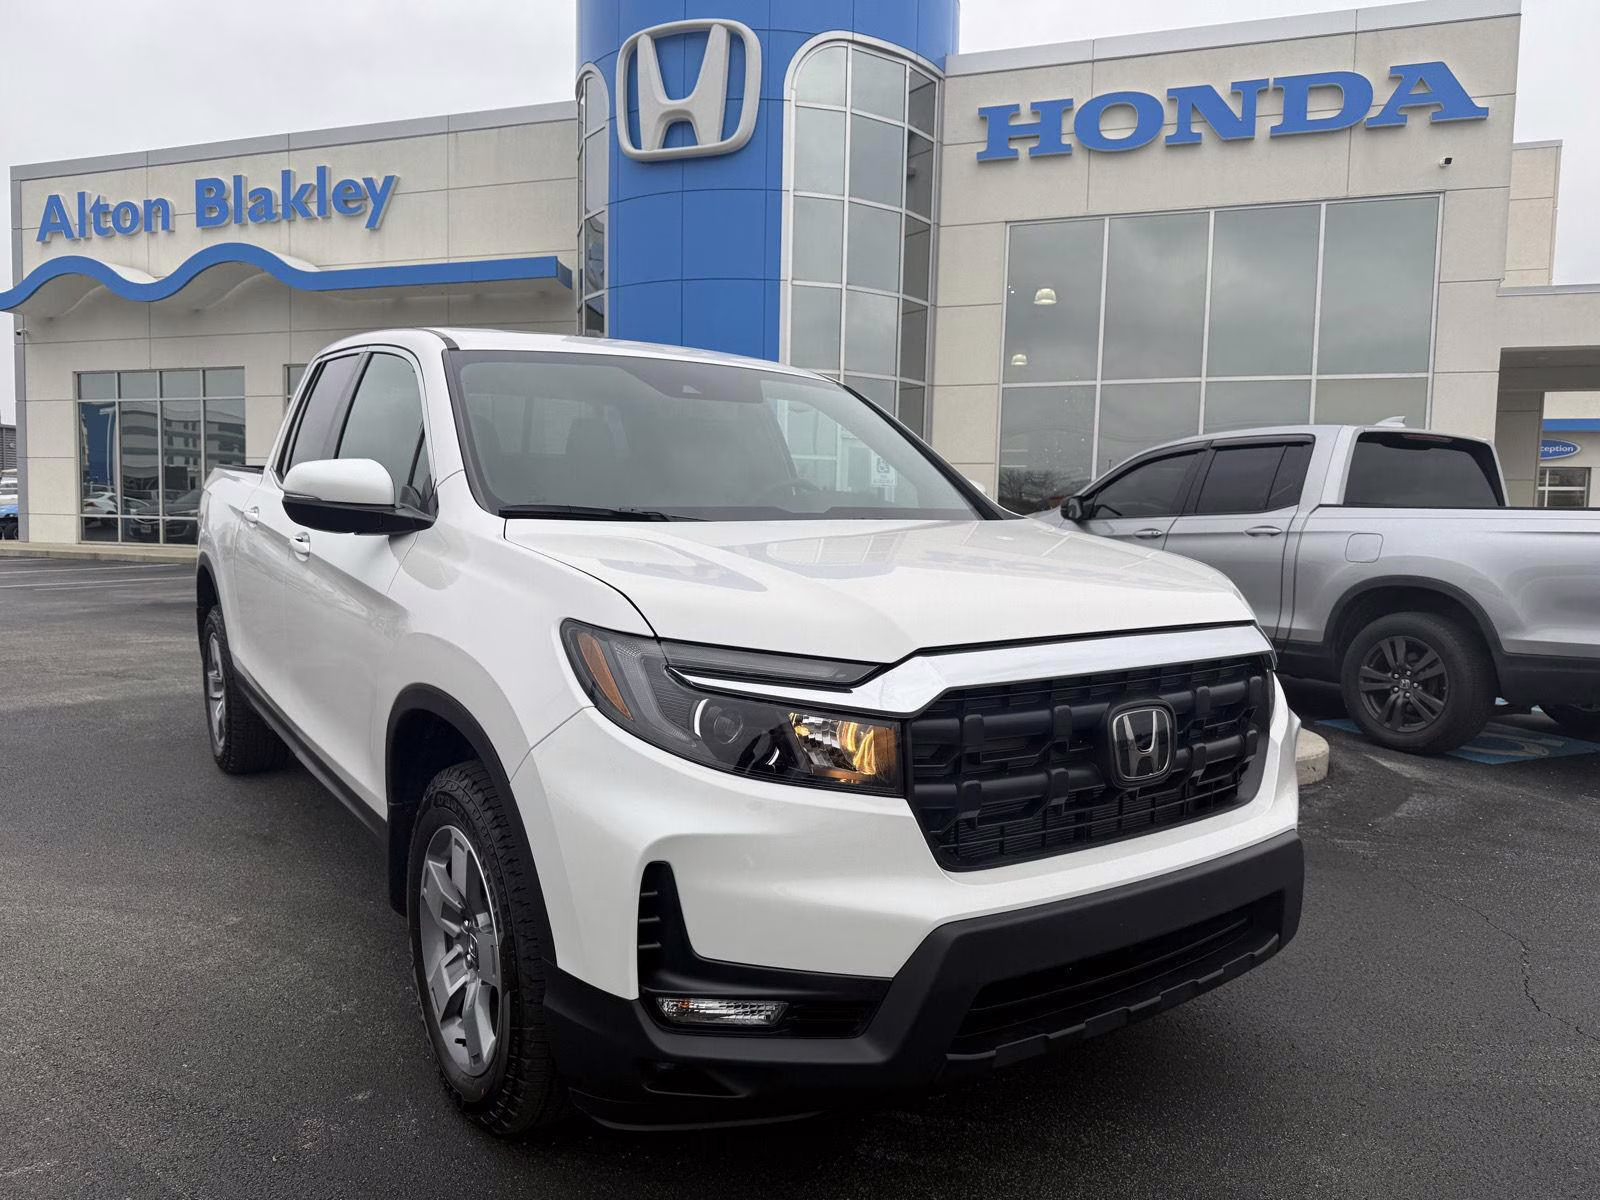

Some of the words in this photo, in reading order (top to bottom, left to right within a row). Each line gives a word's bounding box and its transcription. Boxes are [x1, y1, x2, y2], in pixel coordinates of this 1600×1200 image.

[976, 61, 1489, 161] HONDA
[37, 191, 173, 244] Alton
[194, 165, 398, 231] Blakley
